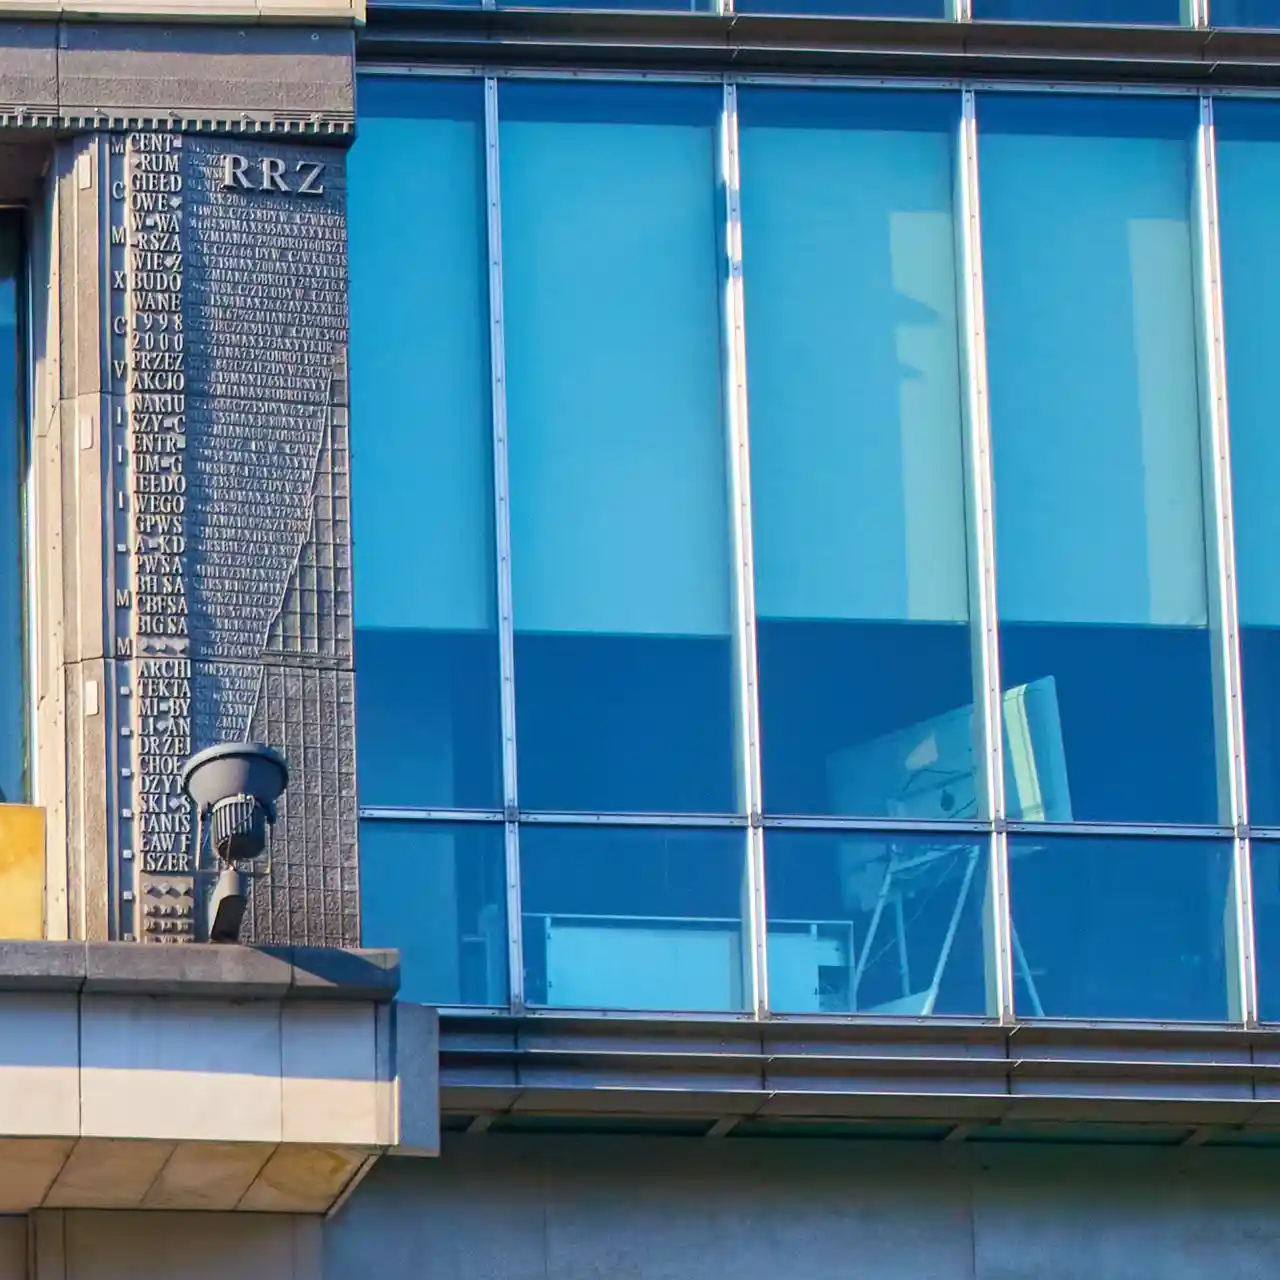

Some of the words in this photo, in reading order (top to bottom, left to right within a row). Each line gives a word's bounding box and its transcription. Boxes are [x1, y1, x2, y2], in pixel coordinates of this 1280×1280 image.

[130, 133, 173, 152] CENT
[141, 154, 180, 172] RUM
[131, 173, 182, 192] GIEŁD
[220, 153, 325, 194] RRZ
[130, 193, 168, 211] OWE
[138, 232, 181, 250] RSZA
[132, 272, 181, 291] BUDO
[132, 292, 182, 311] WANE
[132, 312, 183, 331] 1998
[132, 331, 184, 351] 2000
[132, 351, 184, 370] PRZEZ
[132, 372, 185, 391] AKCJO
[133, 394, 185, 413] NARIU
[134, 435, 177, 453] ENTR
[134, 495, 185, 514] WEGO
[135, 515, 182, 533] GPWS
[137, 595, 188, 614] CBFSA
[138, 660, 191, 678] ARCHI
[137, 679, 191, 697] TEKTA
[138, 737, 191, 755] DRZEJ
[139, 813, 191, 833] TANIS
[139, 852, 189, 872] ISZER
